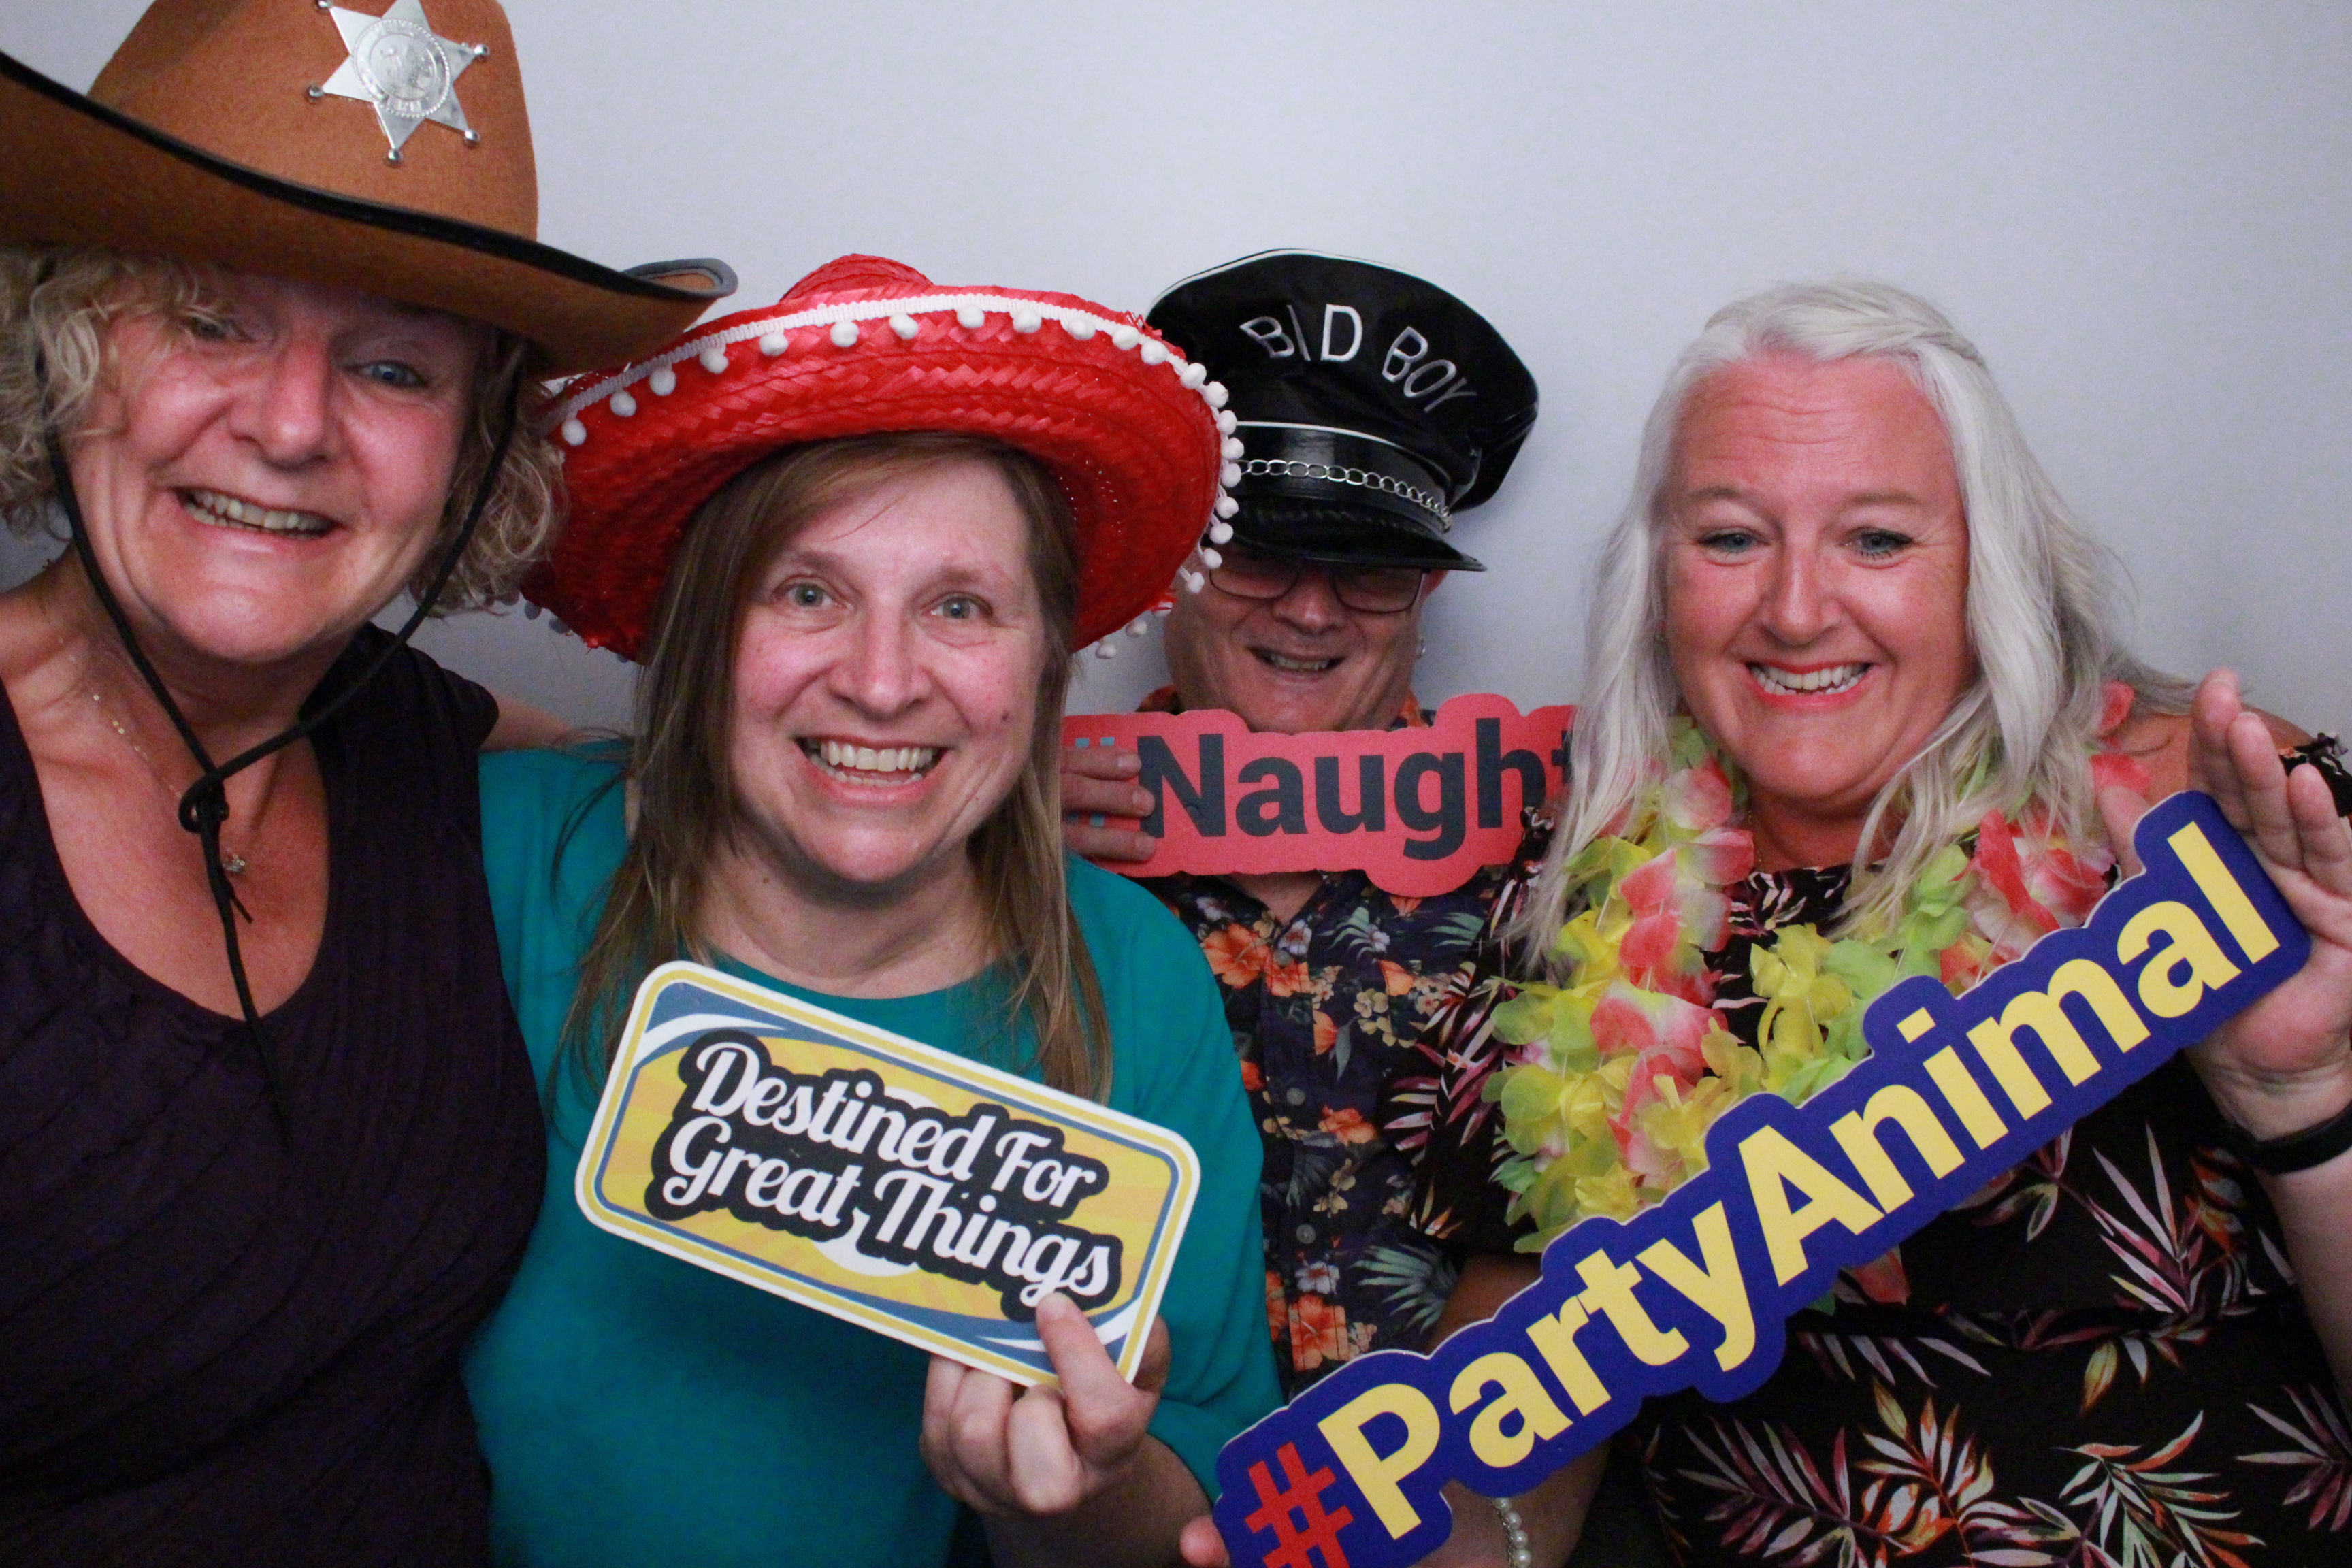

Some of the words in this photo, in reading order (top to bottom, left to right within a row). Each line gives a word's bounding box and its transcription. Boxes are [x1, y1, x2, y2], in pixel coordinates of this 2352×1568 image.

[1382, 326, 1477, 413] BOY
[663, 1116, 862, 1226] Great
[874, 1170, 1110, 1308] Things
[691, 1041, 995, 1181] Destined
[992, 1130, 1097, 1209] For
[1245, 821, 2280, 1568] #PartyAnimal
